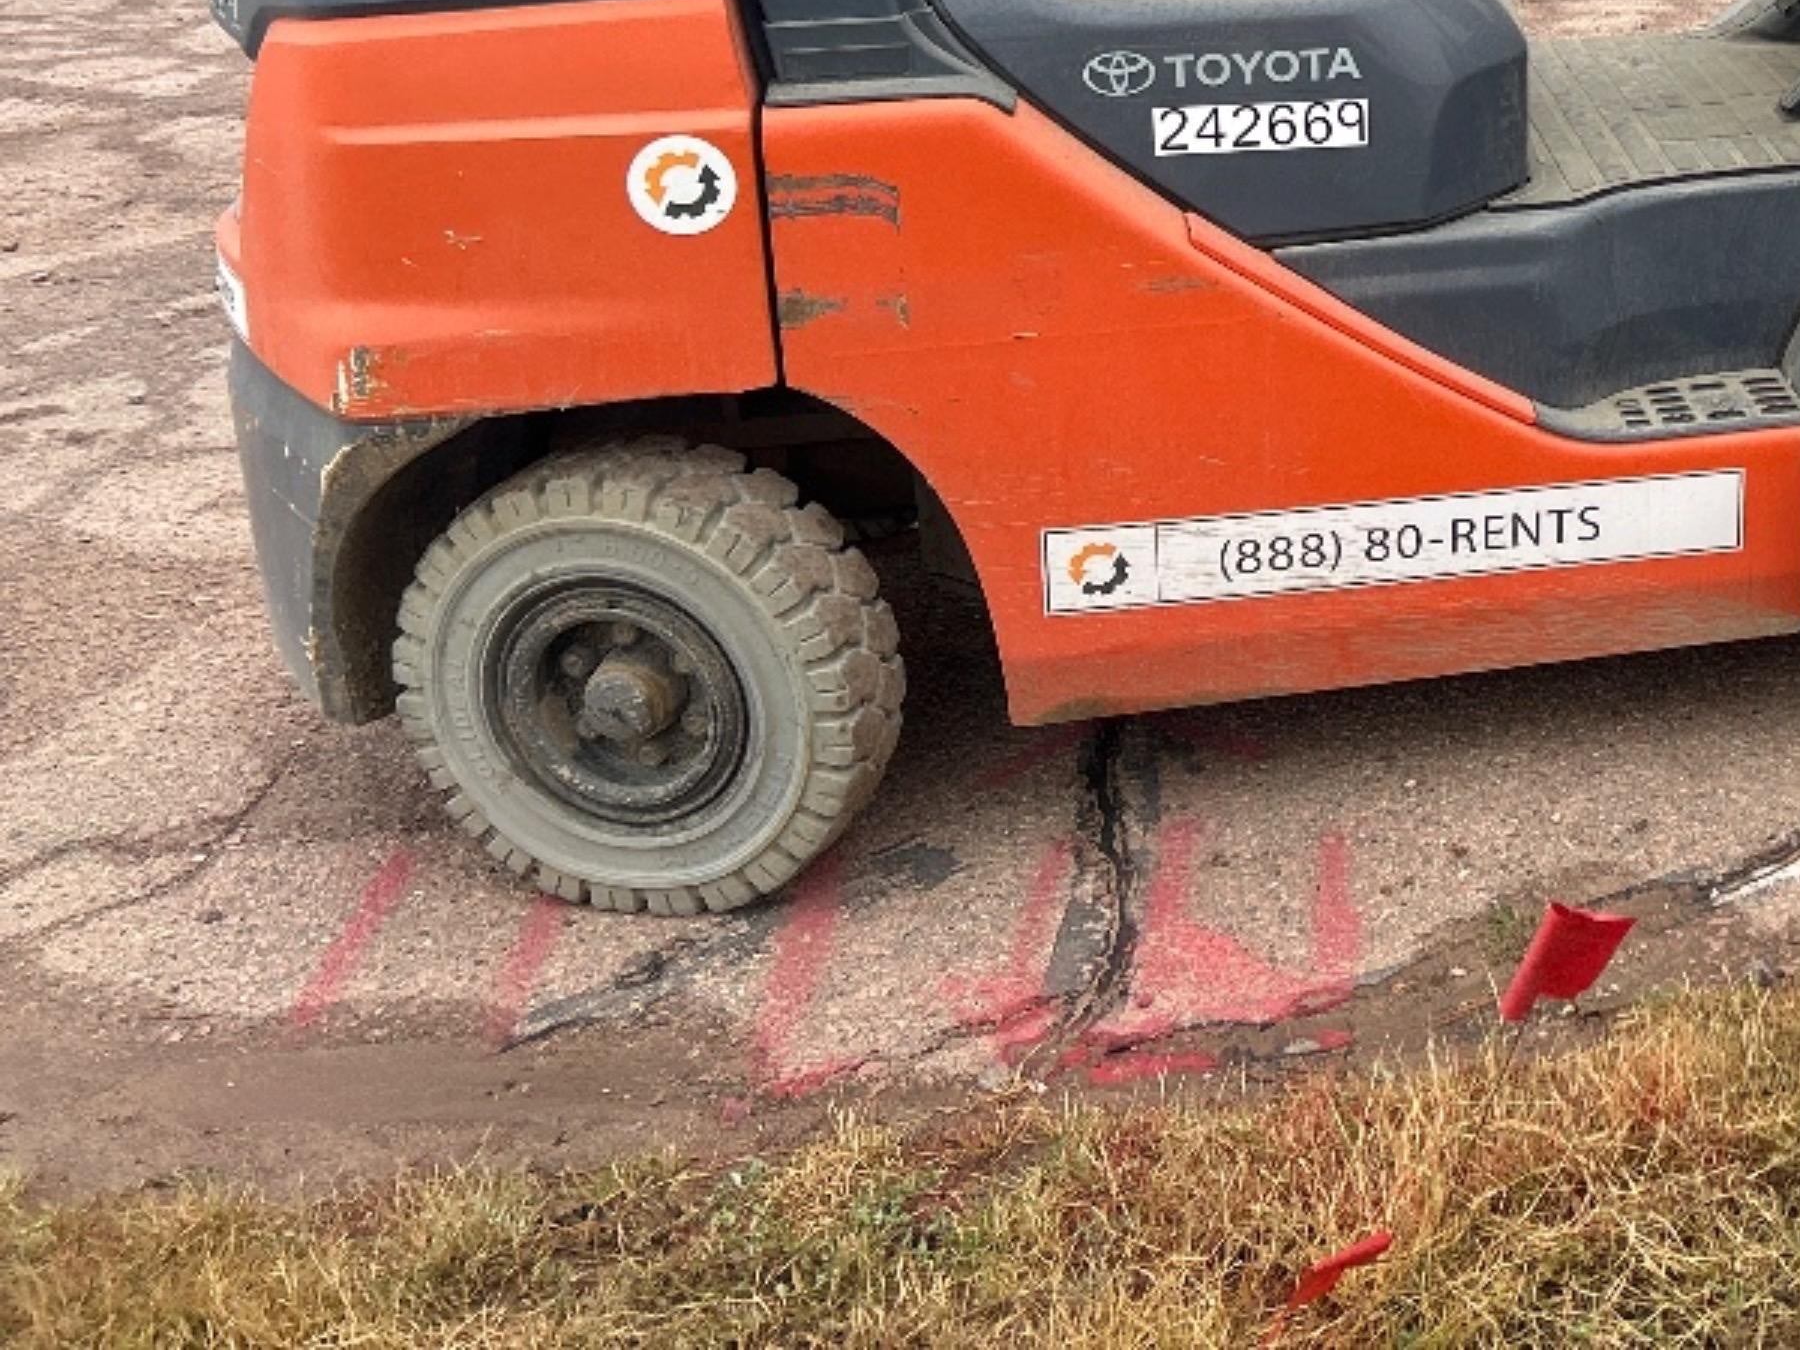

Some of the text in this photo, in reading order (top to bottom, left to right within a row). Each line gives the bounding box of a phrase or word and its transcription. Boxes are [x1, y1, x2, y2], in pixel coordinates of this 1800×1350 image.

[1164, 47, 1362, 88] TOYOTA
[1160, 101, 1367, 152] 242669
[1218, 505, 1602, 582] (888) 80-RENTS
